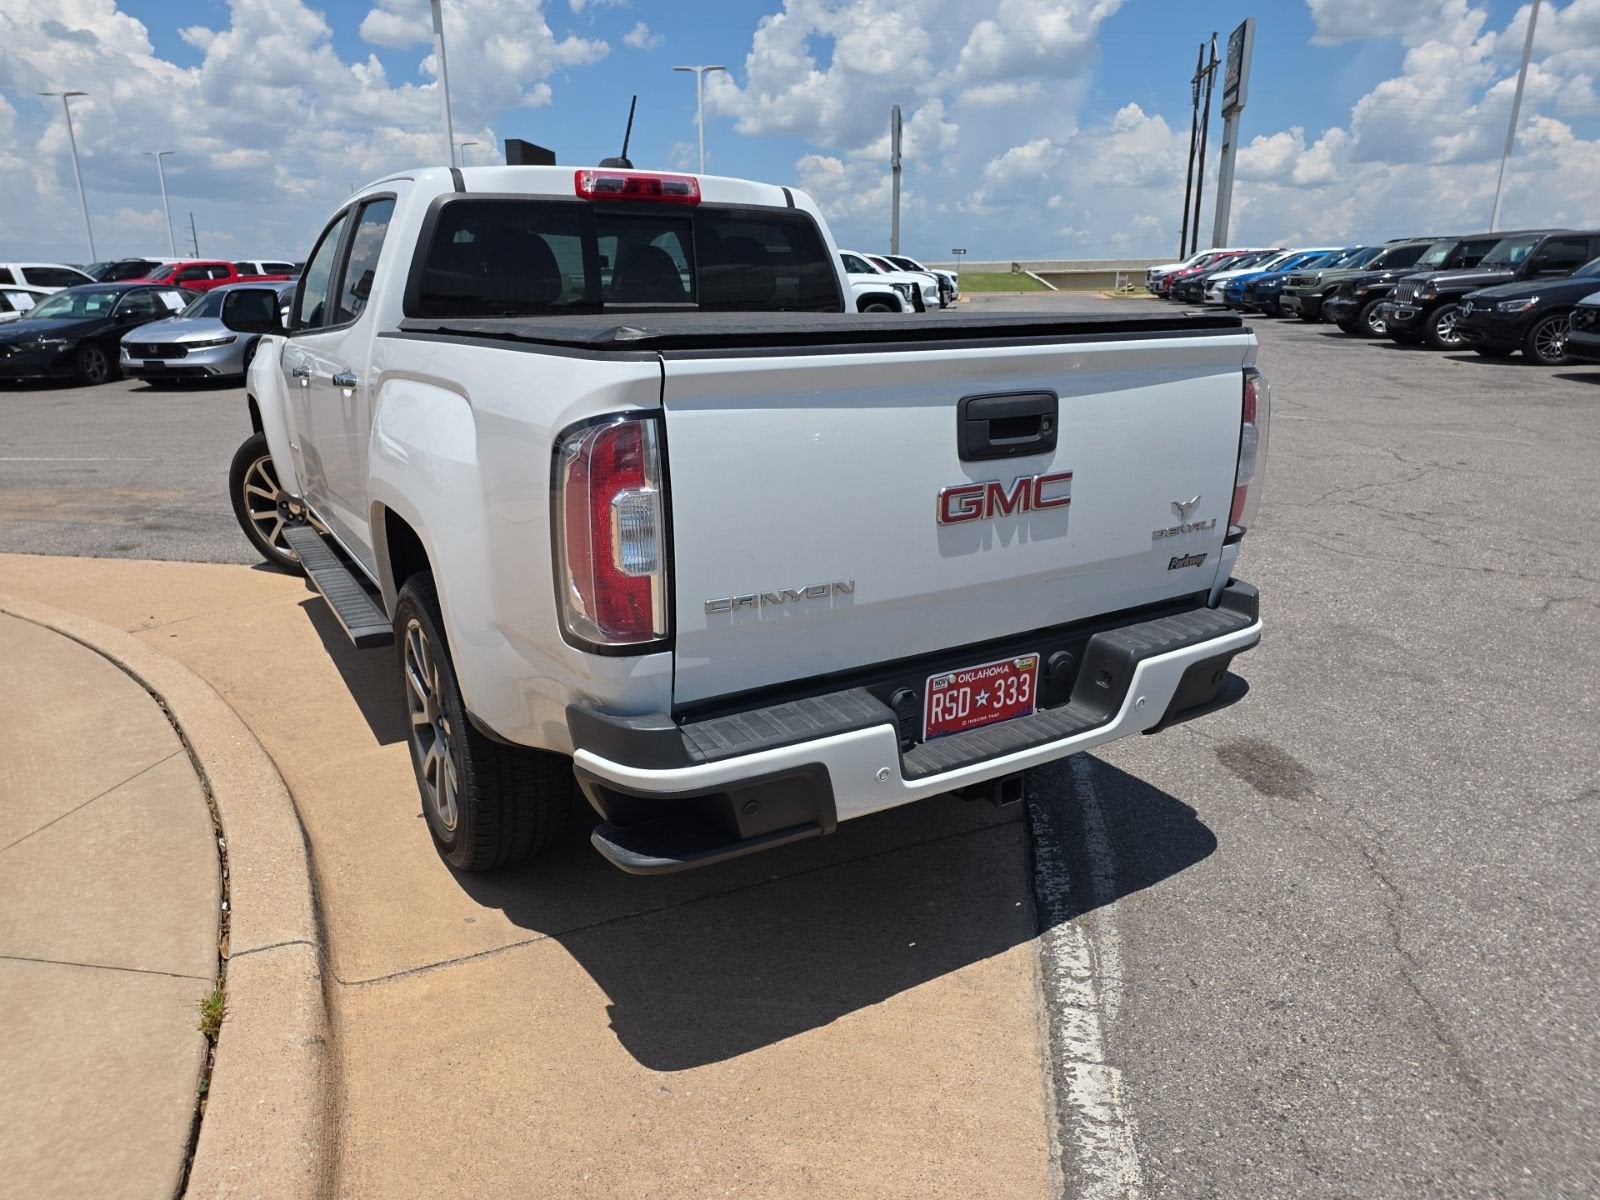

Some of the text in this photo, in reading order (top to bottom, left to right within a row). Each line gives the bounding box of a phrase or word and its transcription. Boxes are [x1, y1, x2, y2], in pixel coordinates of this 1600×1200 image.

[936, 470, 1073, 526] GMC
[1151, 518, 1217, 541] DENALI
[704, 577, 856, 615] CANYON
[958, 665, 1009, 683] OKLAHOMA
[931, 673, 1030, 724] RSD 333
